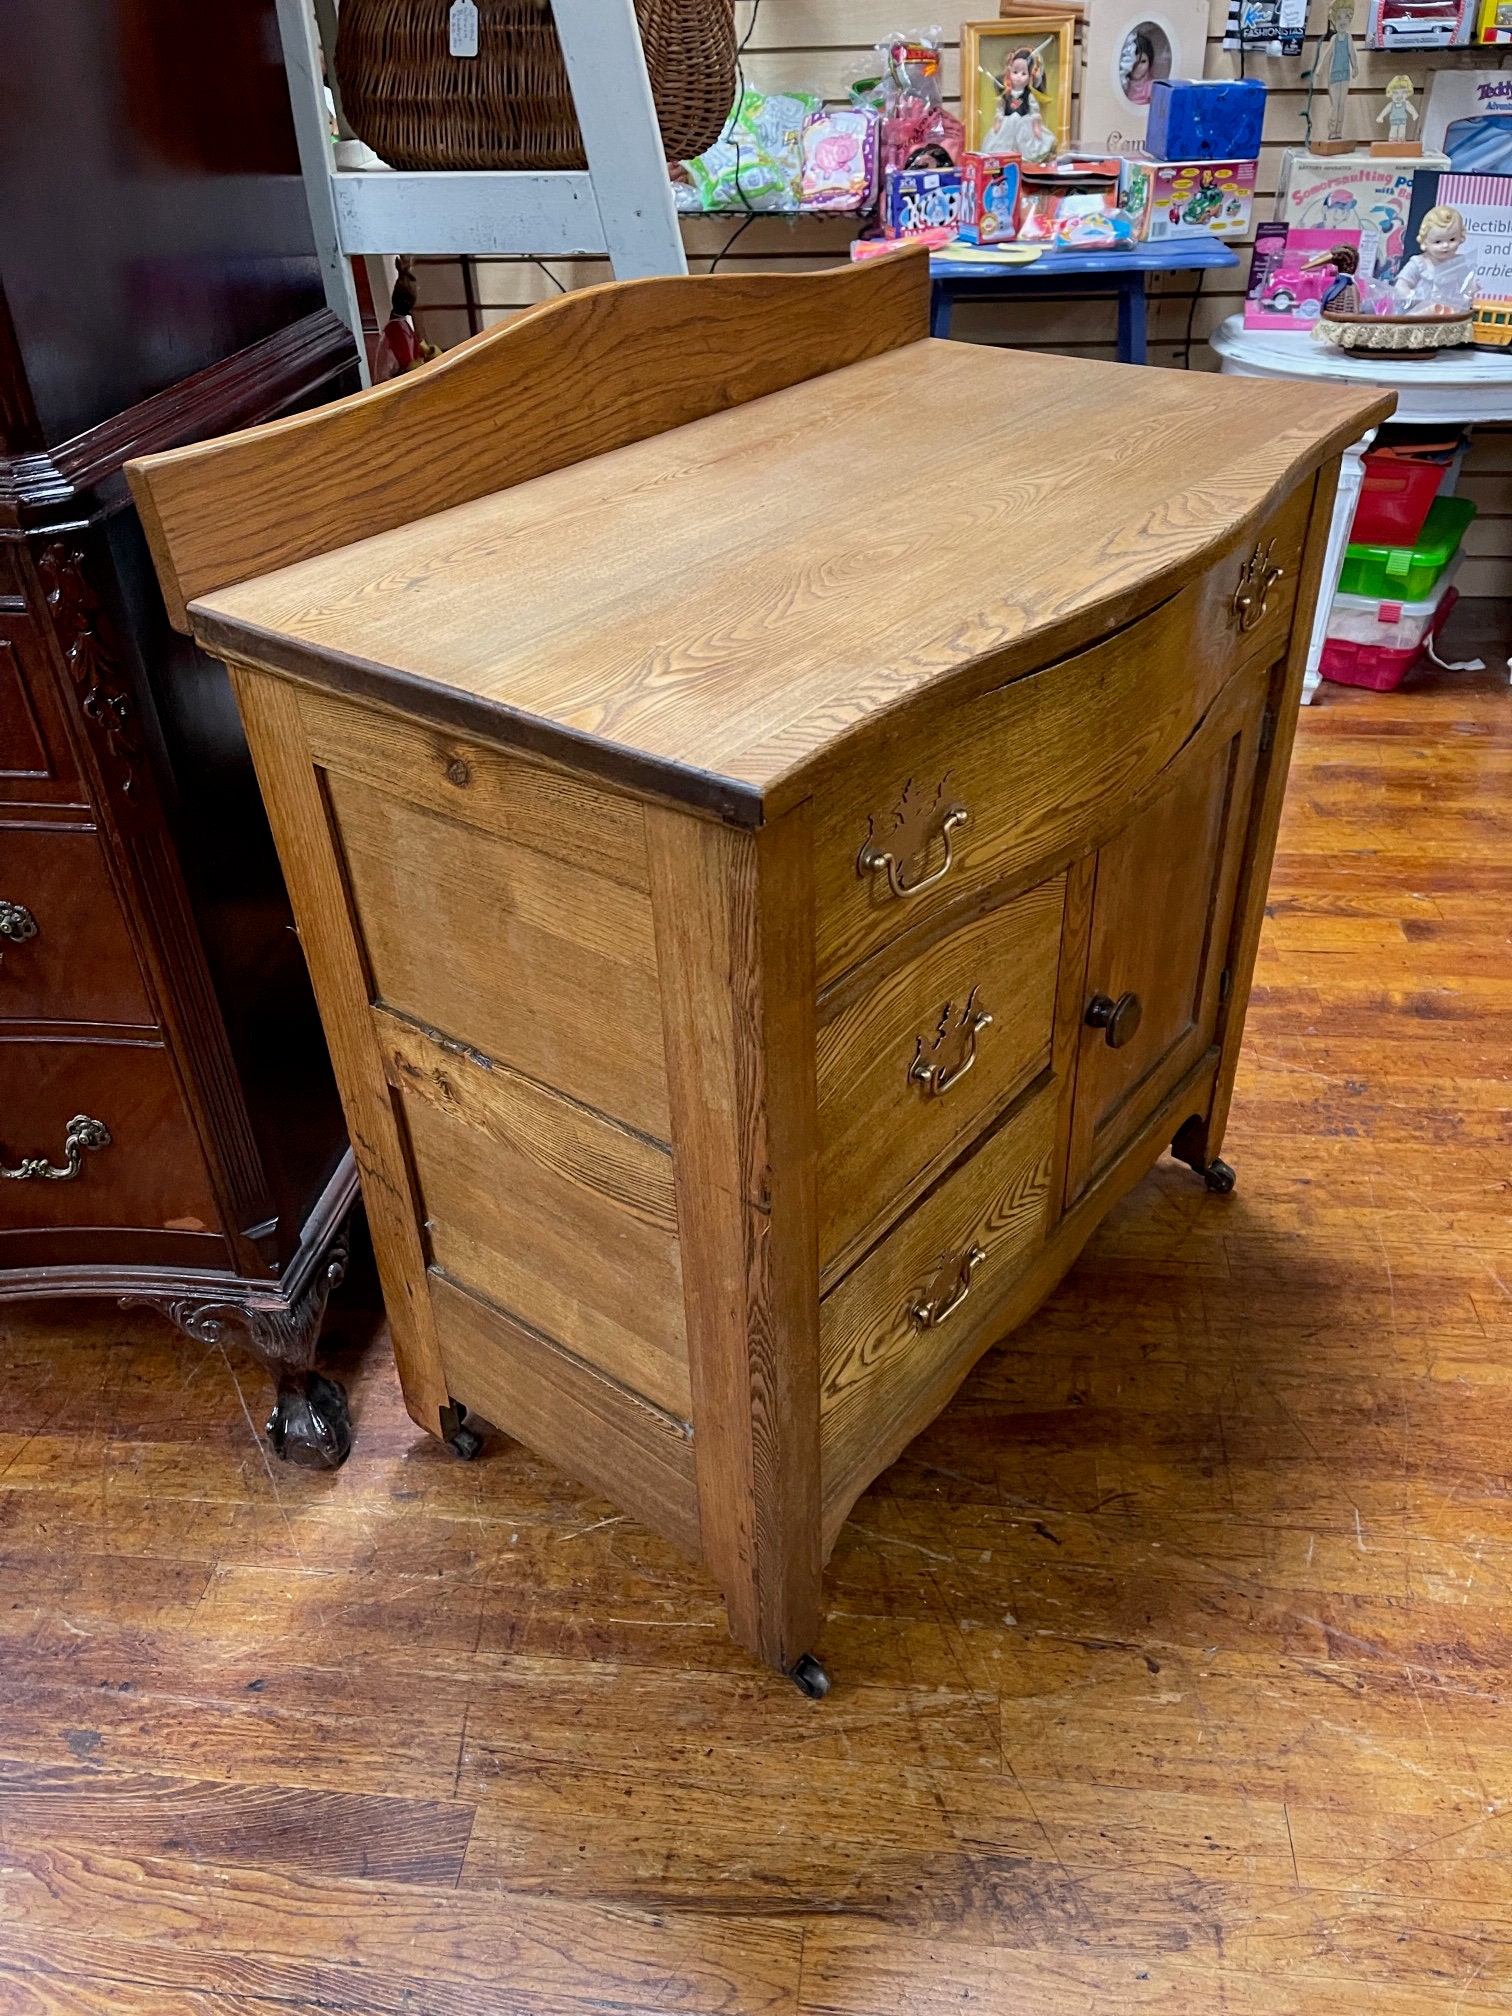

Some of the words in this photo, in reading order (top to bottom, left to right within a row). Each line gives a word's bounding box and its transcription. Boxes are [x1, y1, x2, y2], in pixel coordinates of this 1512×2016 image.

[1241, 3, 1273, 28] Ken
[1243, 27, 1304, 38] FASHIONISTAS
[1292, 169, 1394, 206] Somersaulting
[1375, 187, 1394, 195] with
[1484, 242, 1512, 256] and
[1476, 263, 1512, 278] arbie
